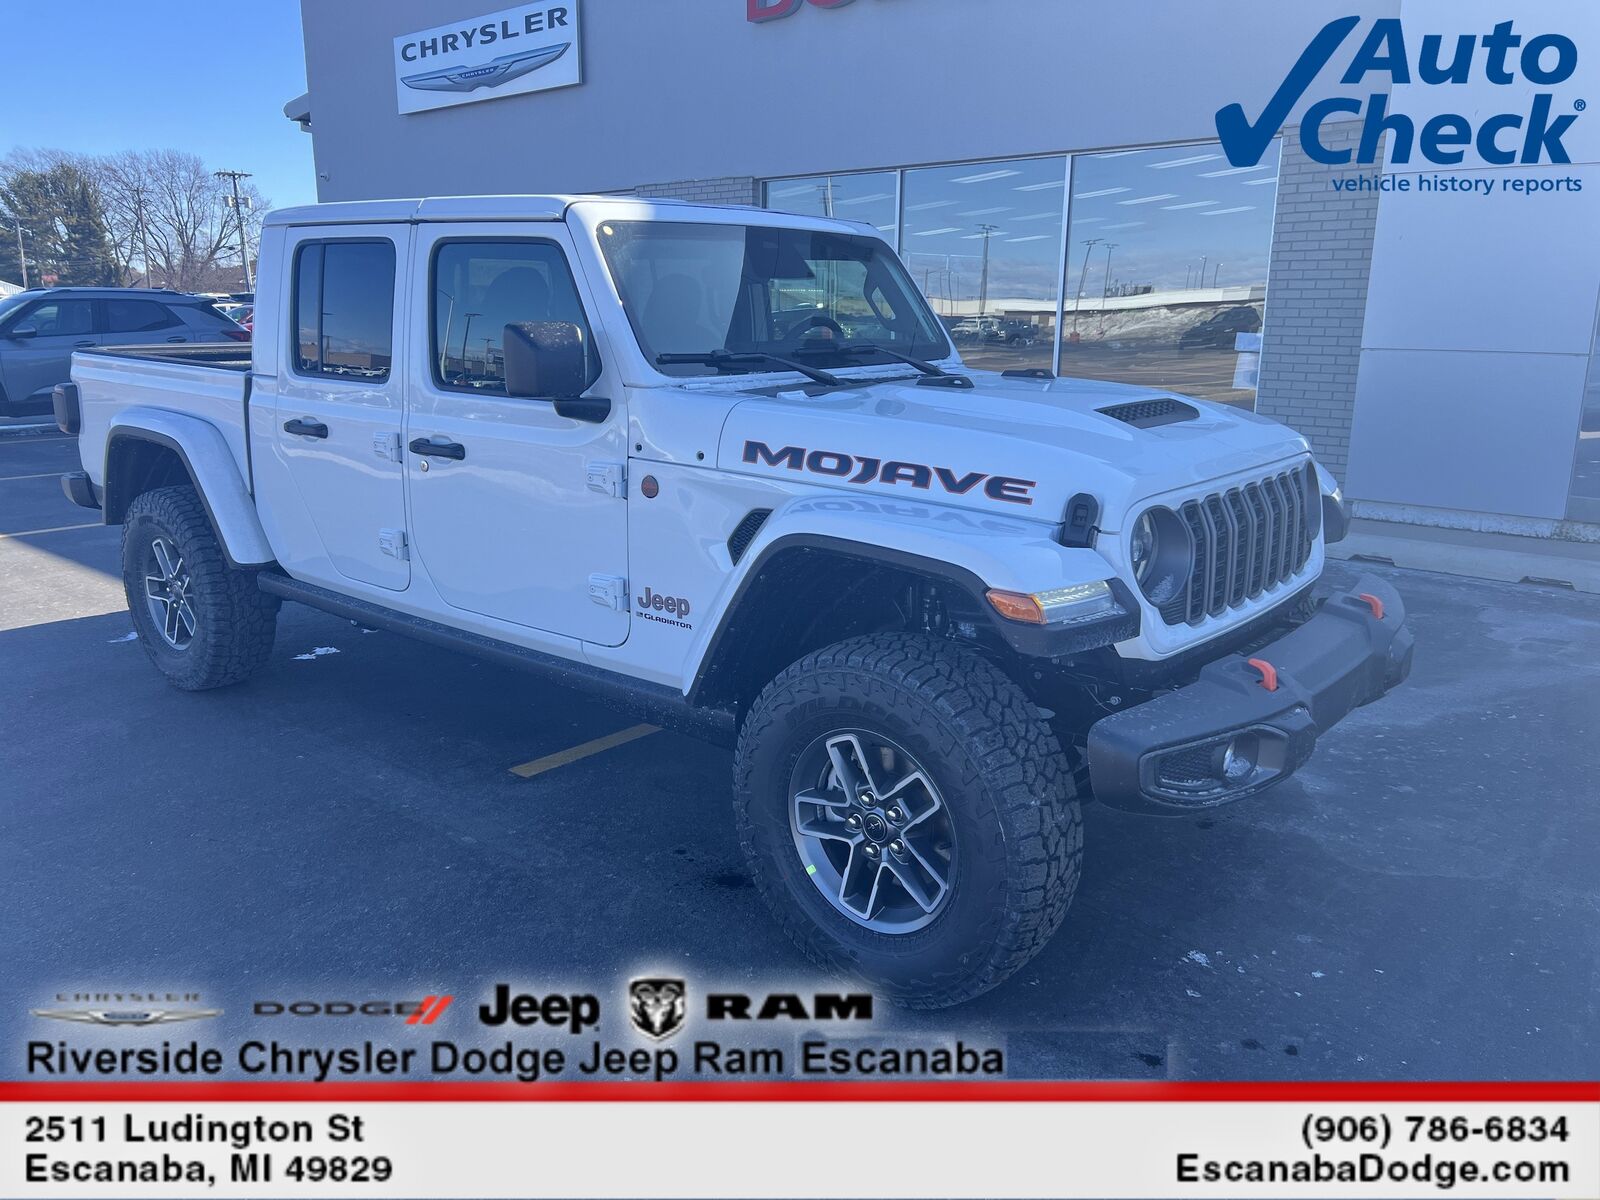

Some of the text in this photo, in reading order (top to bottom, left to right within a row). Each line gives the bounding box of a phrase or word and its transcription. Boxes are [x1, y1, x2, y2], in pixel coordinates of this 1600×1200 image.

[402, 13, 568, 61] CHRYSLER
[742, 440, 1036, 505] MOJAVE
[638, 587, 690, 619] Jeep
[644, 613, 693, 630] GLADIATOR
